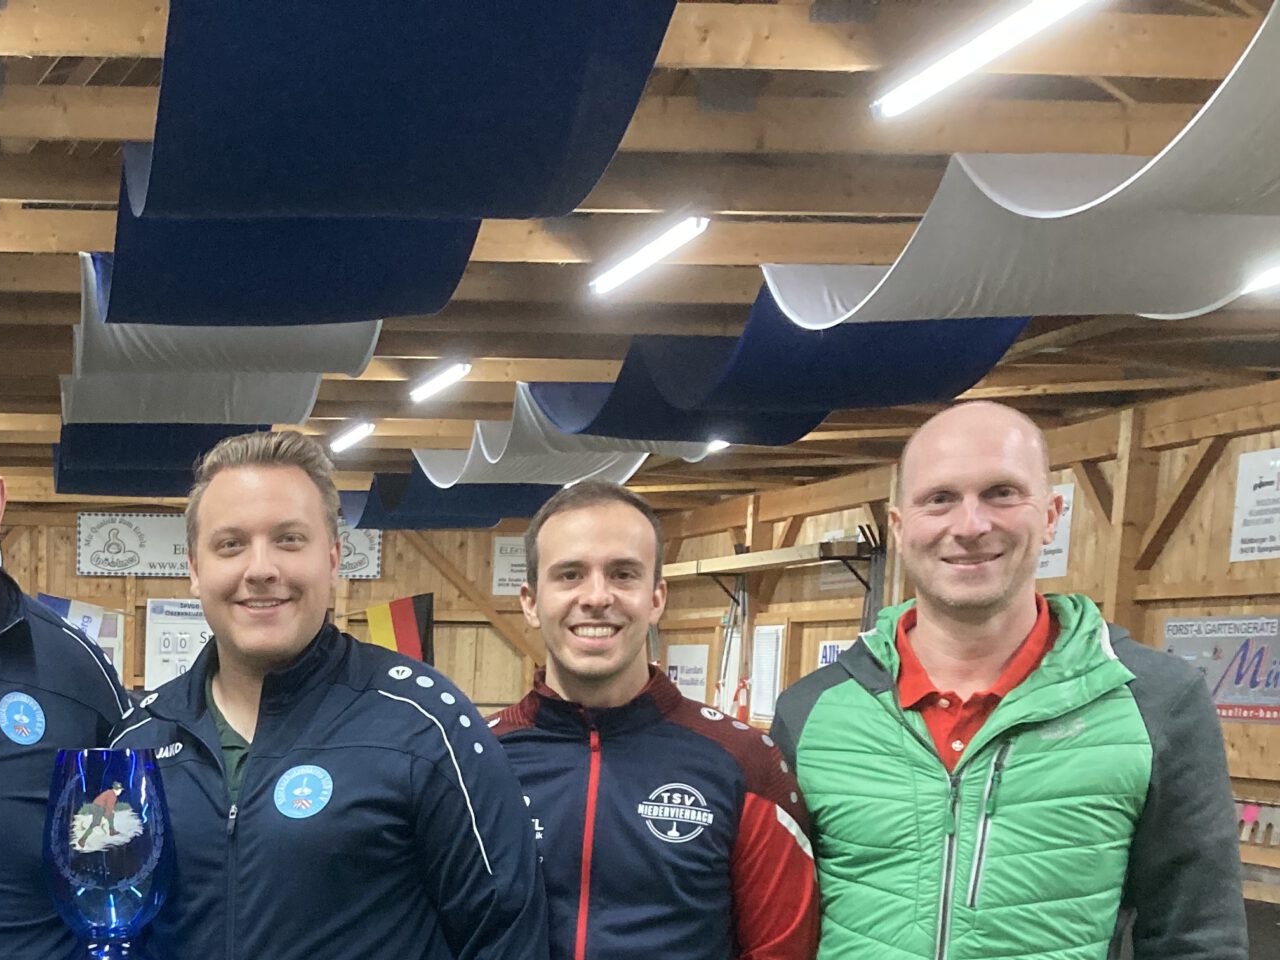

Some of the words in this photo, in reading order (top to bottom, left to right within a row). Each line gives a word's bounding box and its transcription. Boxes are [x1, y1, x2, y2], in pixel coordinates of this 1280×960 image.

[155, 742, 184, 760] JAKO
[661, 792, 696, 806] TSV
[637, 803, 714, 825] NIEDERVIEHBACH
